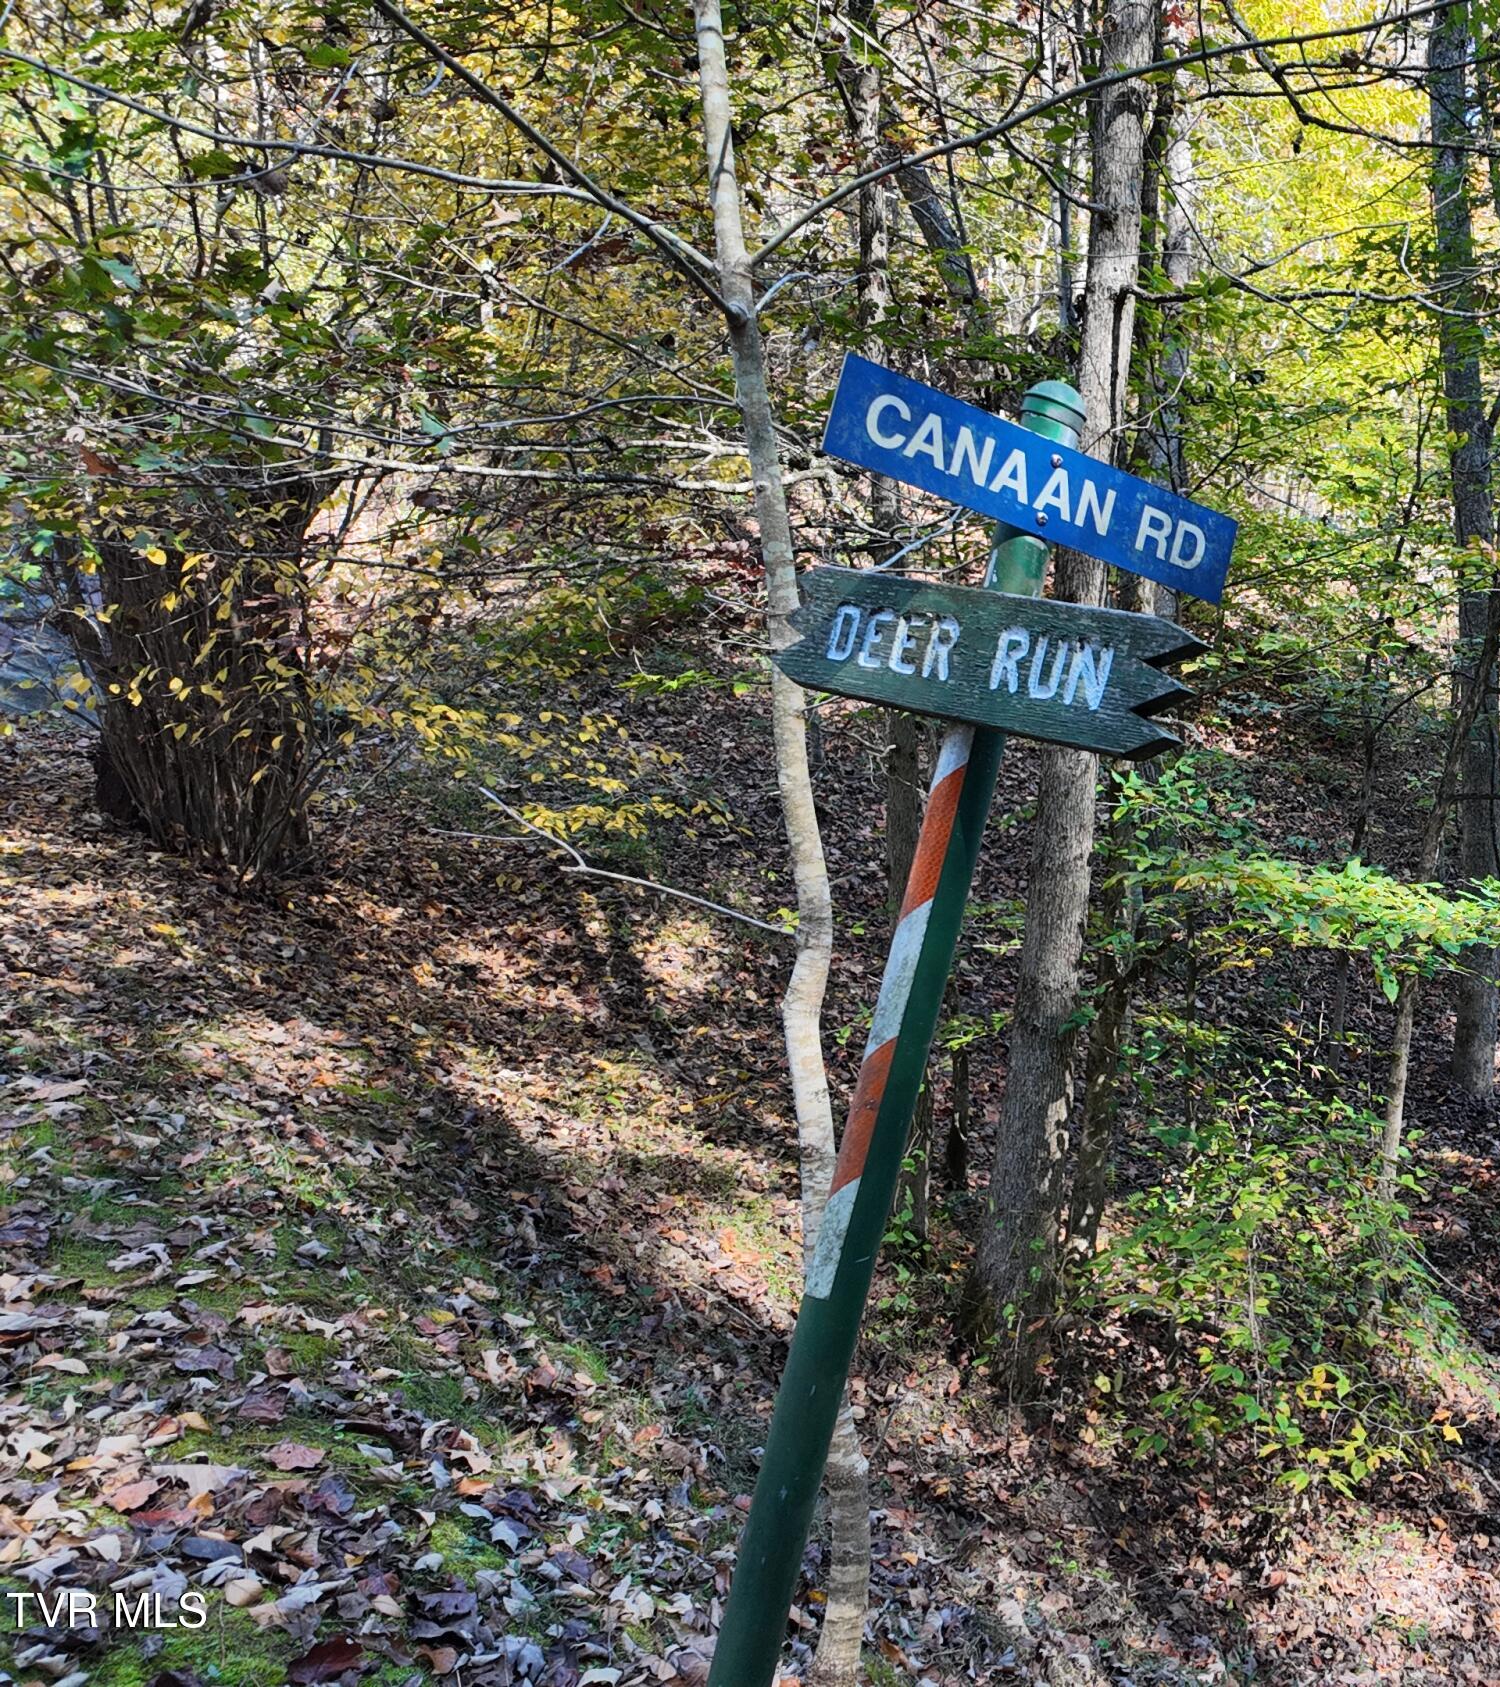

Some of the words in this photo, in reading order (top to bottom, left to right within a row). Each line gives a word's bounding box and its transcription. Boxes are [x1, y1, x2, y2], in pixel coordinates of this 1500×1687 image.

[865, 394, 1117, 537] CANAAN
[1134, 505, 1207, 571] RD
[825, 605, 961, 682] DEER
[989, 626, 1114, 711] RUN
